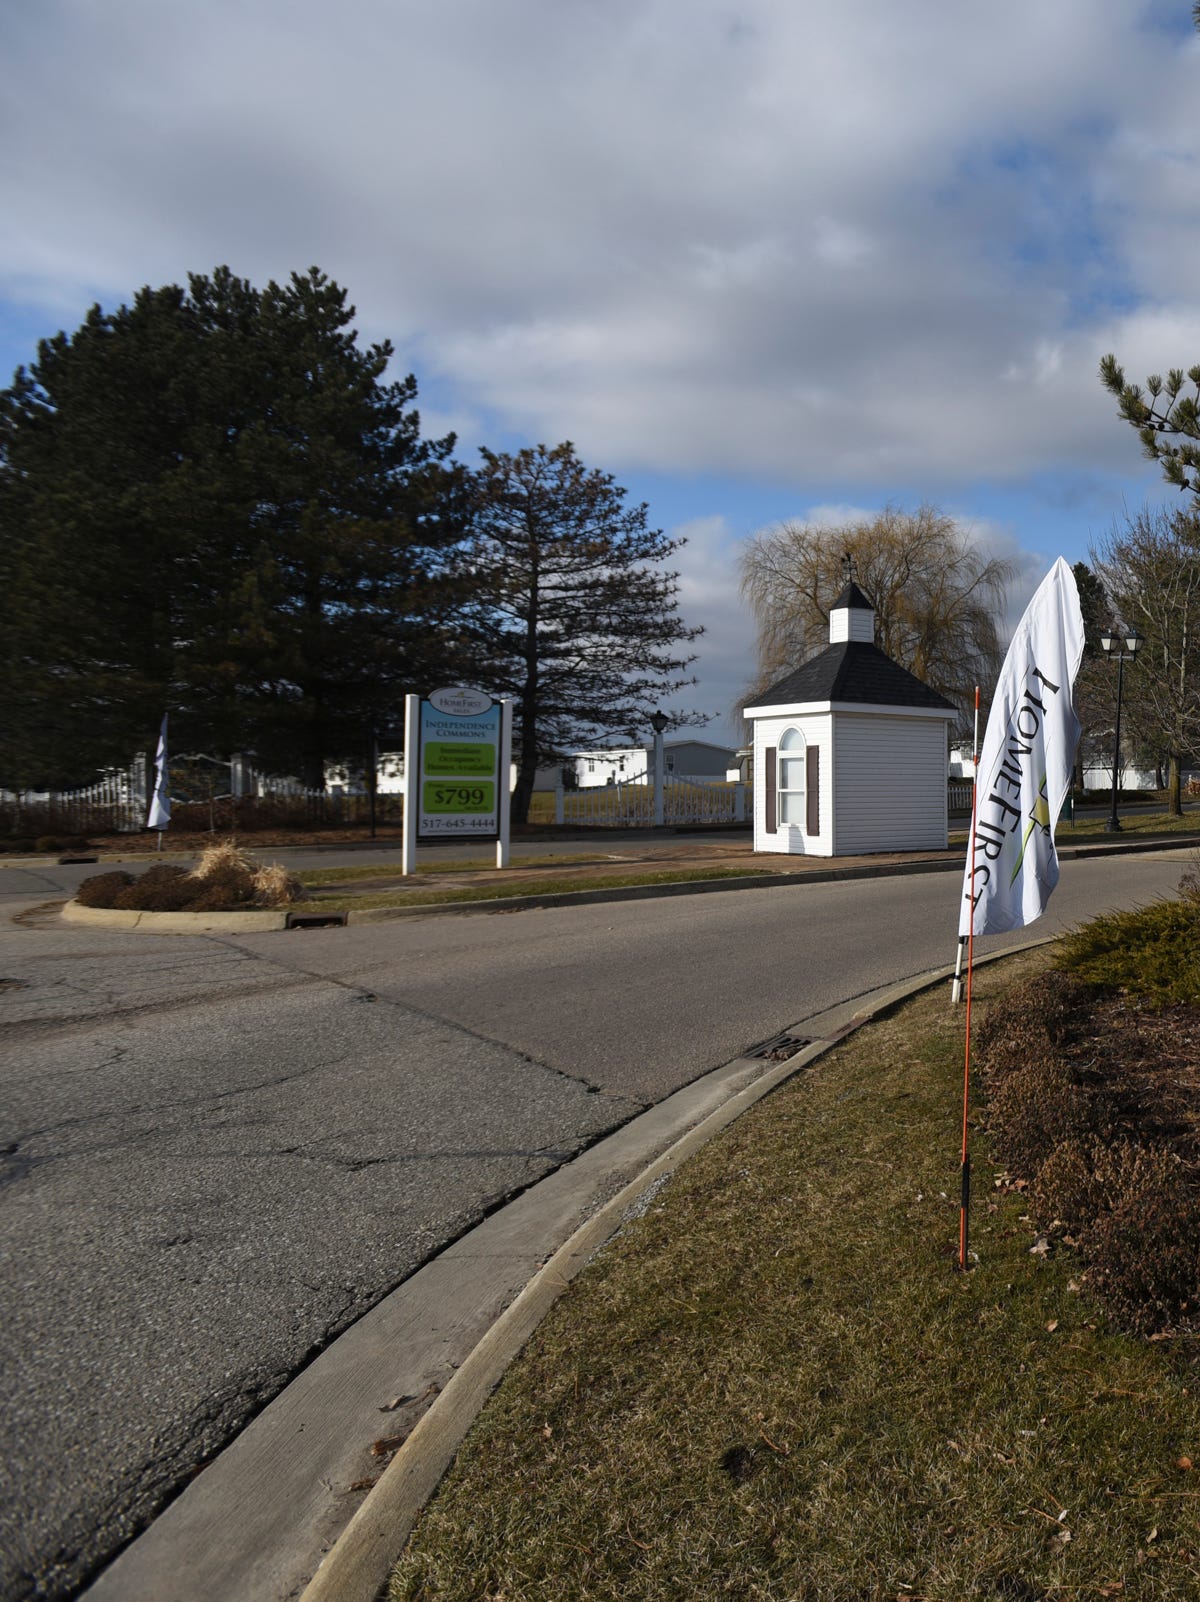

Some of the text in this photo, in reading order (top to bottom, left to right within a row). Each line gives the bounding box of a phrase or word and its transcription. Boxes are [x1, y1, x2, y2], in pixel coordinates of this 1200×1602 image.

[425, 720, 496, 731] INDEPENDENCE
[436, 730, 486, 738] COMMONS
[434, 788, 485, 806] $799
[422, 819, 495, 829] 517-645-4444
